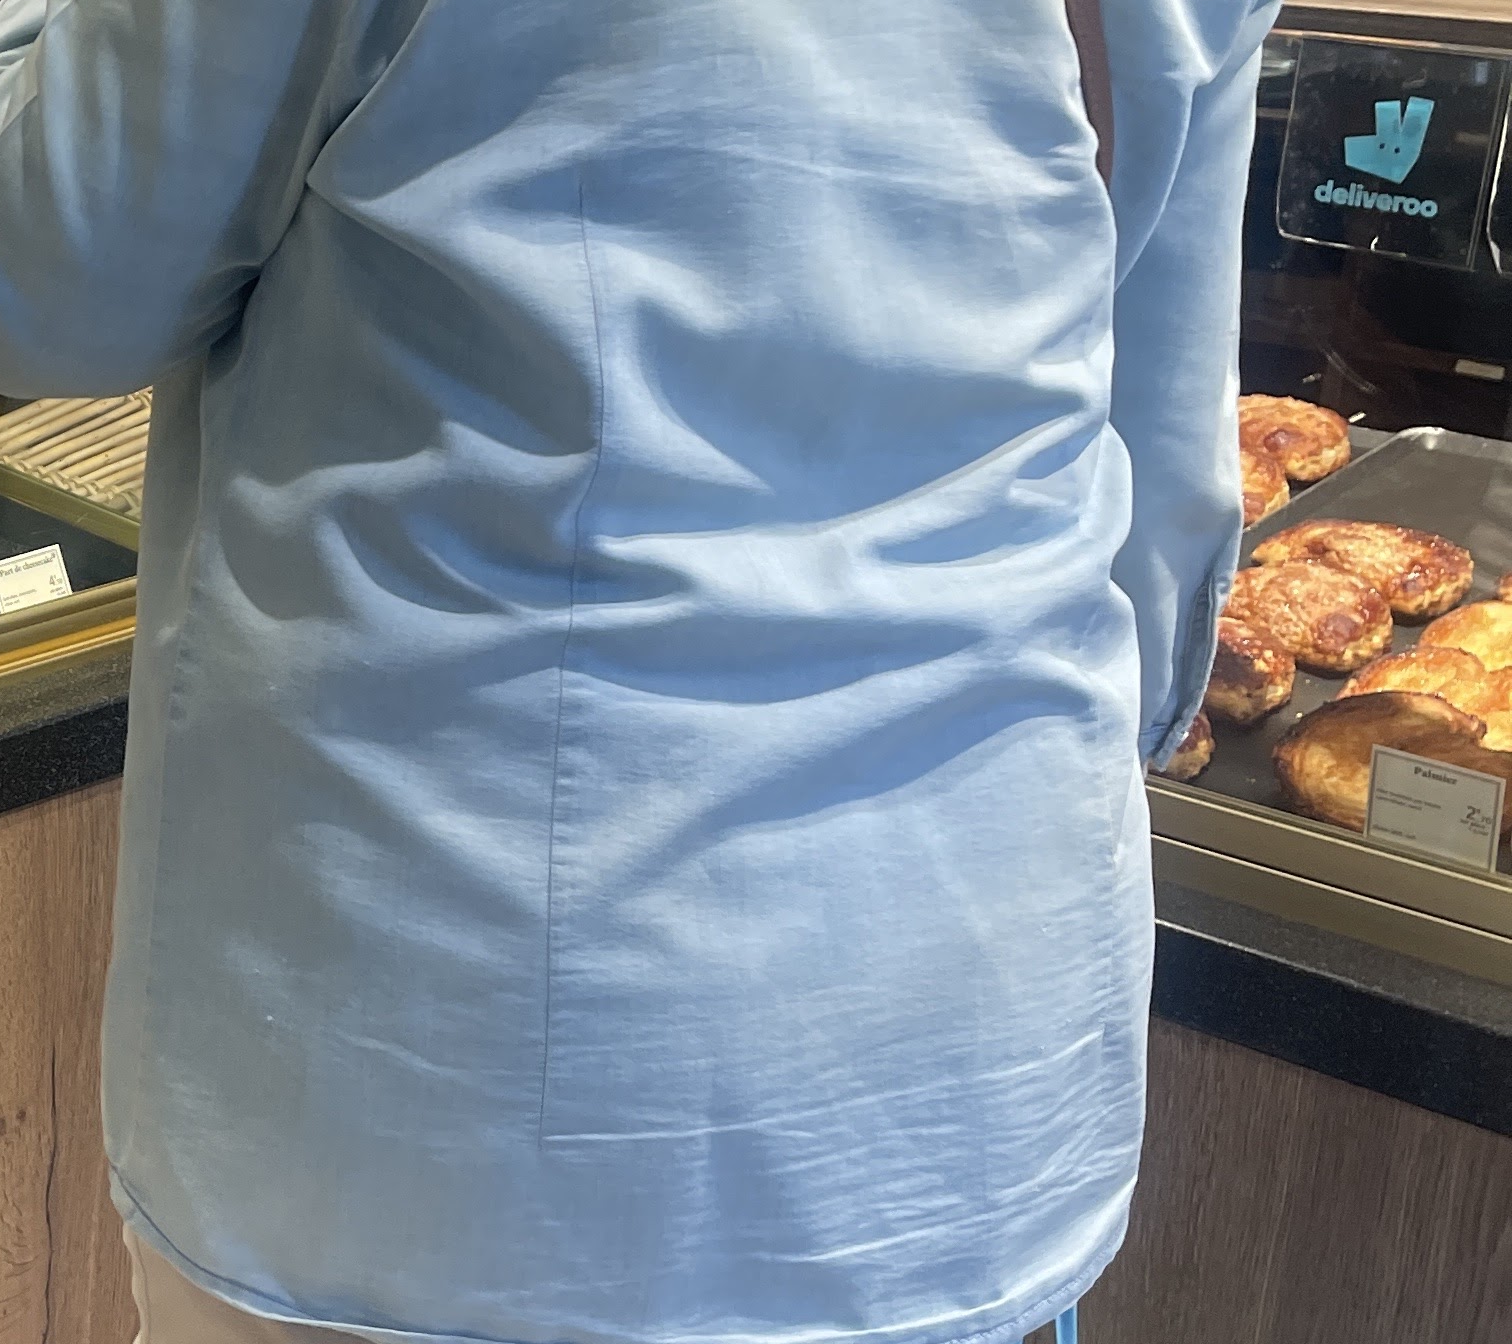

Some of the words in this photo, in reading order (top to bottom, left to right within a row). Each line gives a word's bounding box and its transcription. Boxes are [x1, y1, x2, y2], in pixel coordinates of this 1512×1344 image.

[1314, 179, 1438, 218] deliveroo
[14, 563, 22, 573] de
[1413, 765, 1458, 785] Palmier
